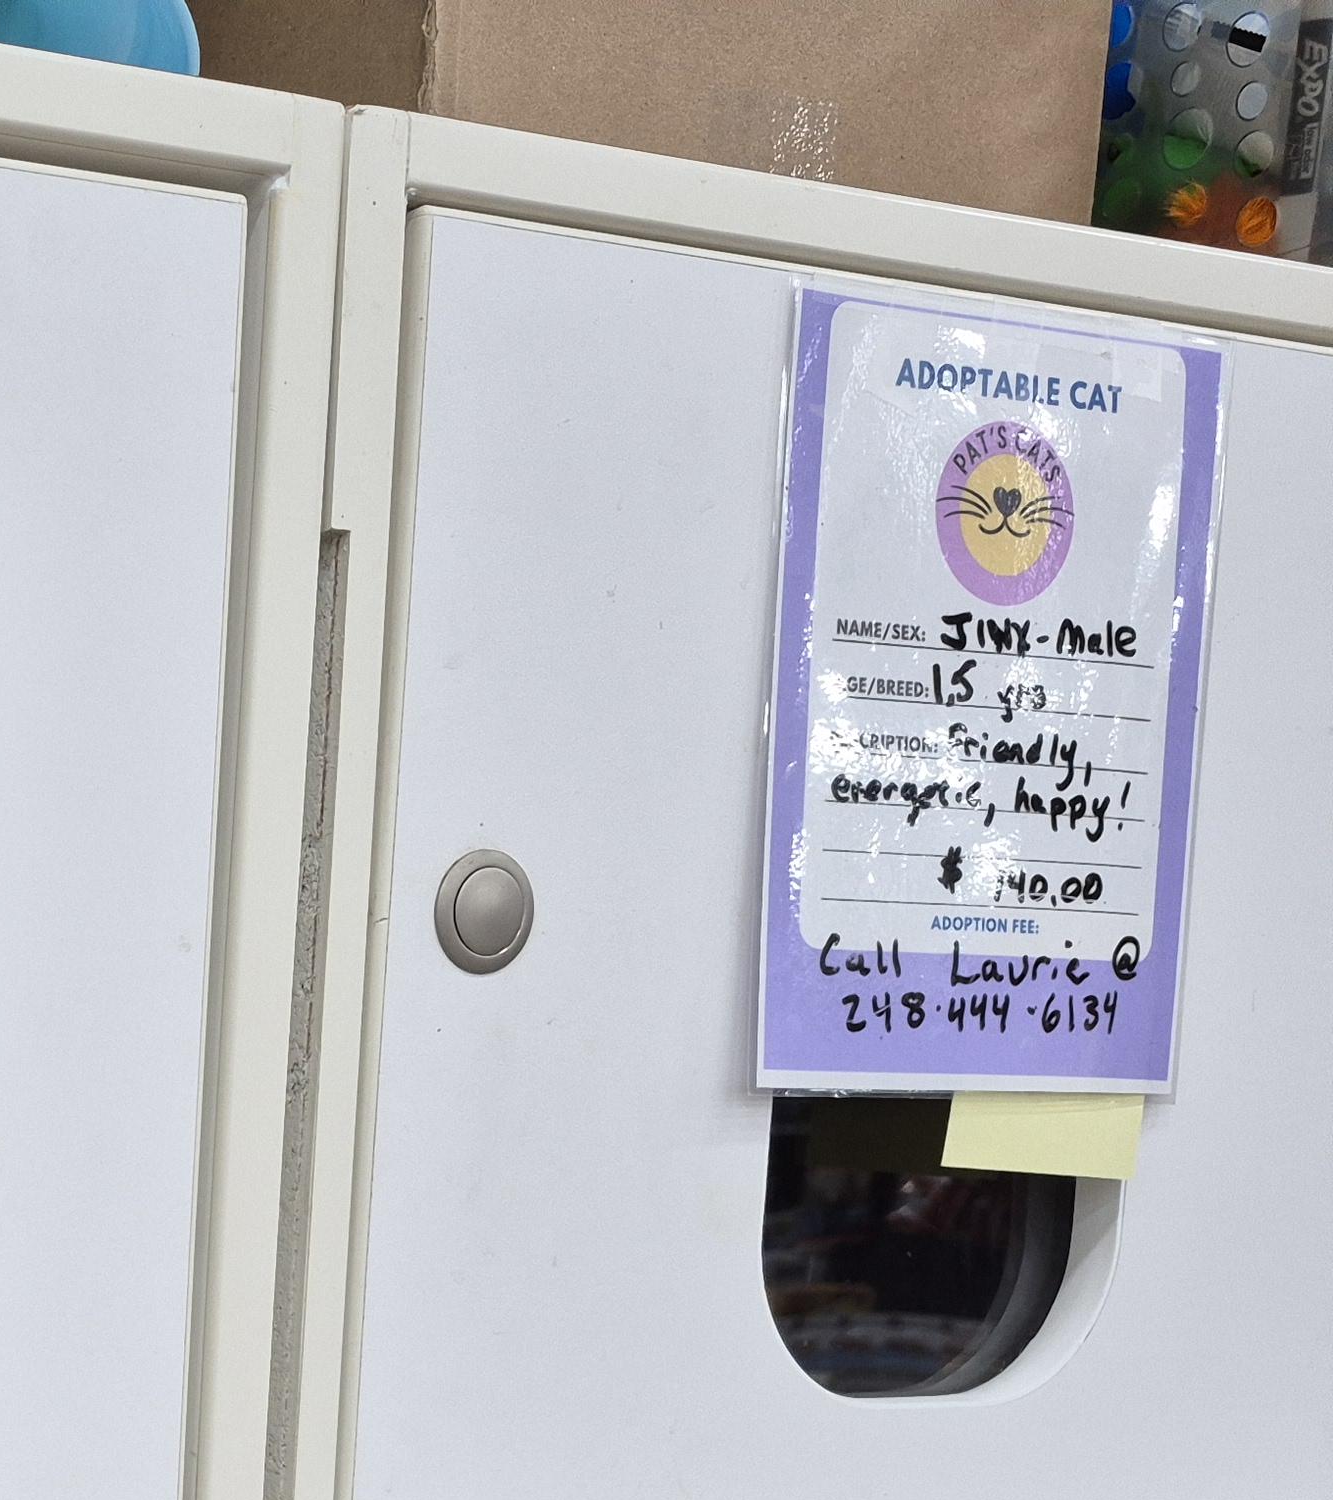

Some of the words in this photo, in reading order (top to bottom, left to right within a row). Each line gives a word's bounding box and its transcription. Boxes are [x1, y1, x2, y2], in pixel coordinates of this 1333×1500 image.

[895, 357, 1060, 407] ADOPTABLE
[1070, 380, 1123, 414] CAT
[952, 424, 1008, 476] PAT'S
[1014, 428, 1061, 483] CATS
[836, 618, 927, 642] NAME/SEX:
[839, 675, 930, 698] GE/BREED:
[831, 730, 938, 754] CRIPTION:
[1014, 776, 1131, 842] happy!
[937, 846, 963, 893] $
[930, 916, 1008, 933] ADOPTION
[1011, 919, 1040, 934] FEE:
[819, 932, 902, 977] Call
[950, 940, 1090, 986] Laurie
[1111, 935, 1141, 981] @
